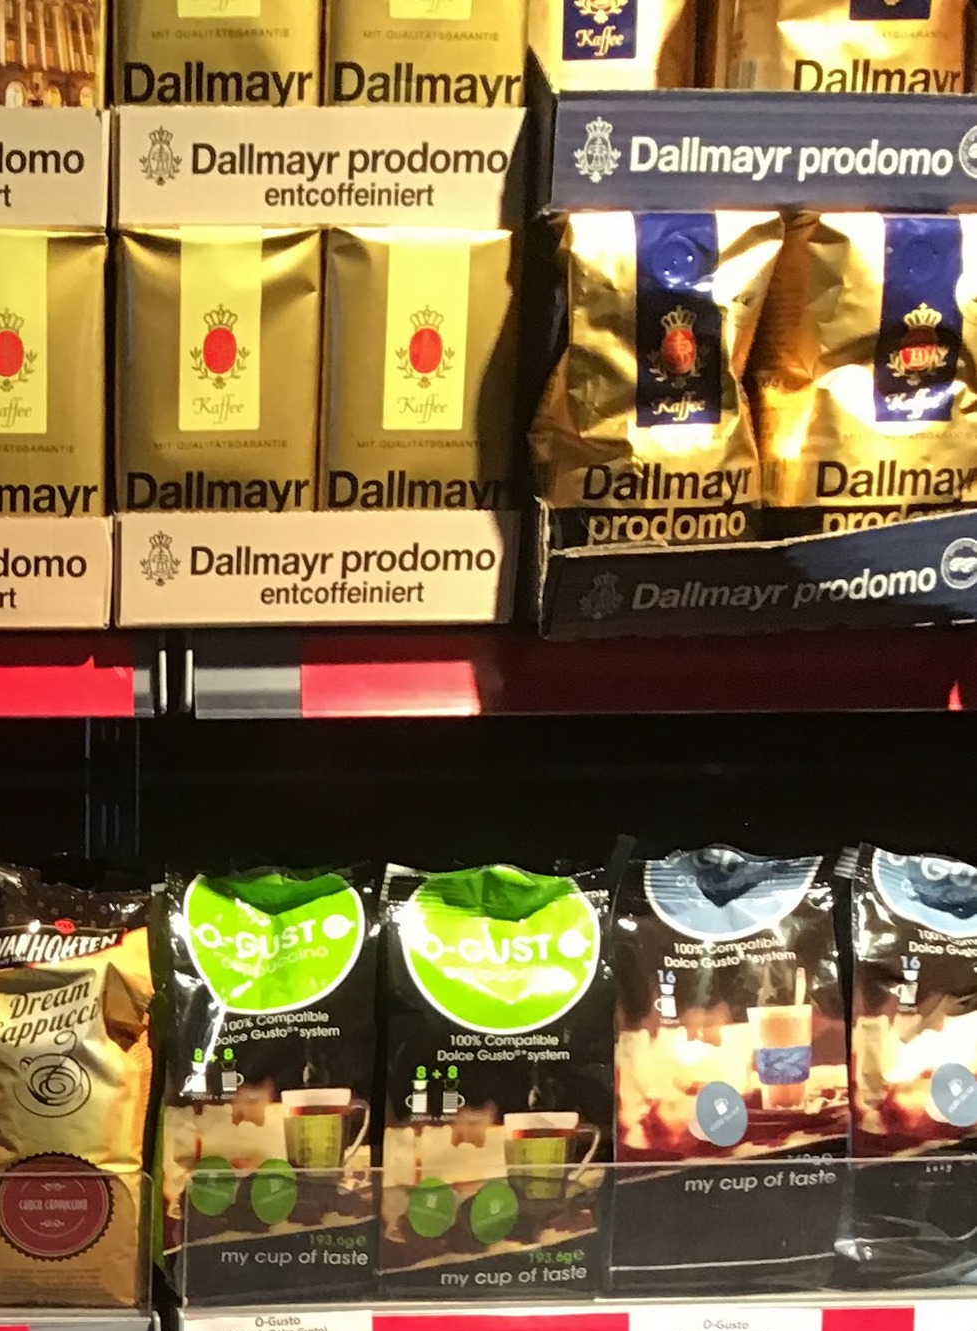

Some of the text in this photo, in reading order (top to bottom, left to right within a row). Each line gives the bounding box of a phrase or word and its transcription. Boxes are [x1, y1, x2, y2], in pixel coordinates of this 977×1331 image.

[576, 27, 625, 57] Kaffee
[124, 61, 312, 106] Dallmayr
[334, 62, 522, 107] Dallmayr
[191, 142, 509, 182] Dallmayr prodomo
[630, 137, 953, 182] Dallmayr prodomo
[264, 182, 434, 207] entcoffeiniert
[816, 460, 977, 503] Dallmay
[190, 543, 496, 581] Dallmayr prodomo
[261, 581, 424, 606] entcoffeiniert
[909, 941, 943, 954] Dolce
[900, 955, 921, 970] 16
[657, 970, 676, 985] 16
[9, 980, 91, 1020] Dream
[223, 1011, 329, 1032] 100% Compatible
[449, 1034, 559, 1047] 100% Compatible
[685, 1169, 837, 1193] my cup of taste
[222, 1249, 369, 1267] my cup of taste
[441, 1265, 588, 1286] my cup of taste
[254, 1316, 301, 1327] O-Gusto
[703, 1320, 749, 1330] O-Gusto
